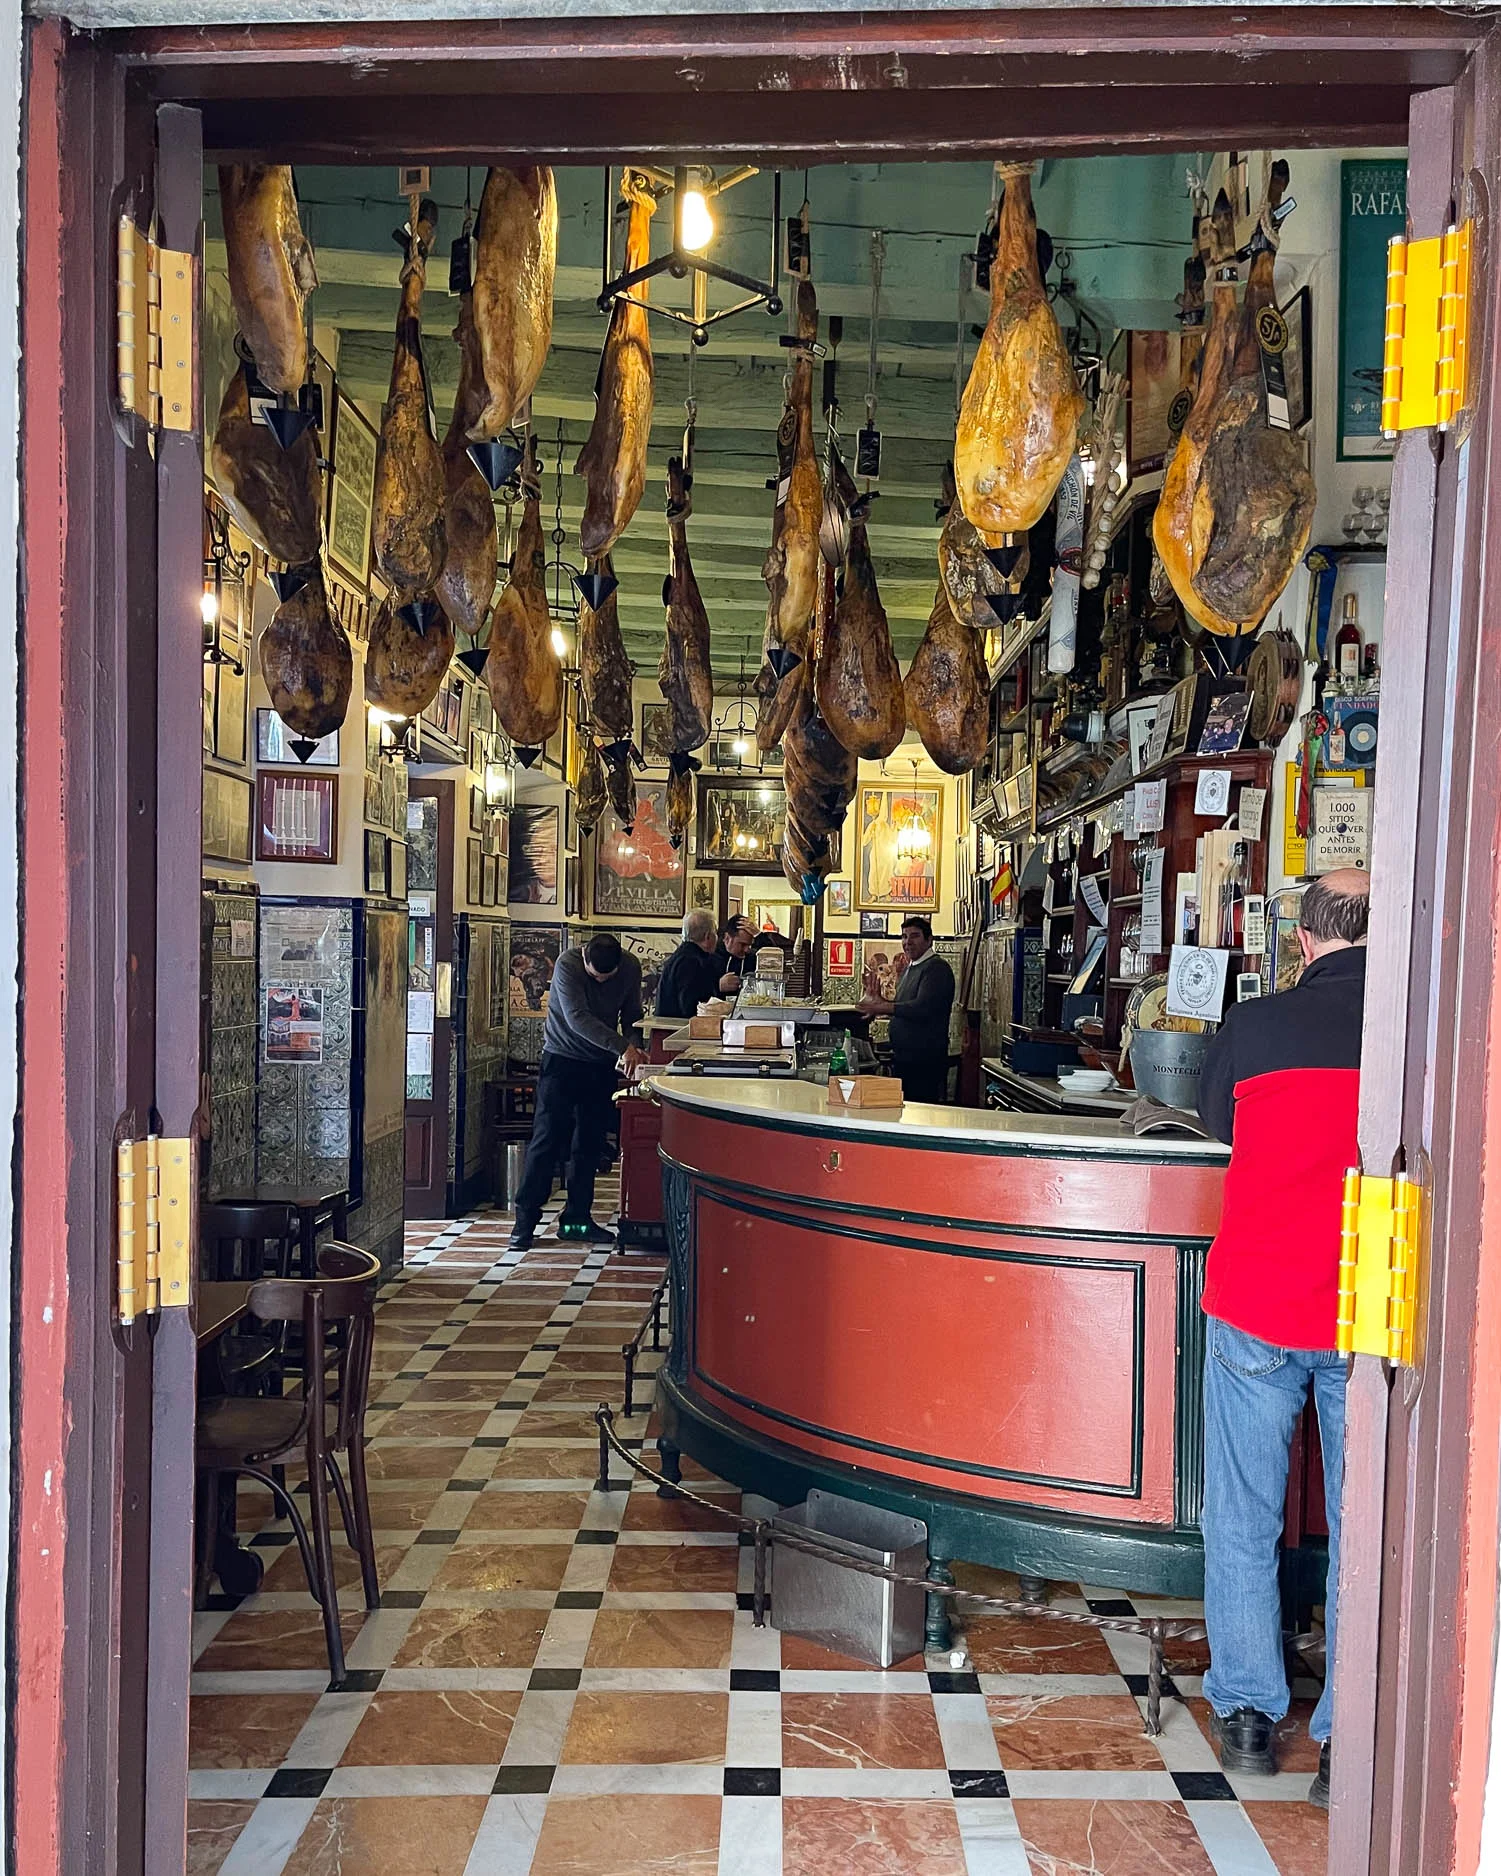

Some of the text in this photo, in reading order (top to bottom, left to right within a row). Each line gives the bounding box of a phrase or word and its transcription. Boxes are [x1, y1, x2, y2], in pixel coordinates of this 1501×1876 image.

[1351, 192, 1407, 216] RAFA
[1330, 802, 1356, 812] 1.000
[1329, 815, 1355, 823] SITIOS
[1318, 825, 1364, 834] QUE VER
[1327, 836, 1355, 844] ANTES
[1320, 846, 1361, 854] DE MORIR
[890, 876, 934, 897] SEVILLA
[624, 935, 665, 960] Toros
[1152, 1064, 1201, 1076] MONTECILL
